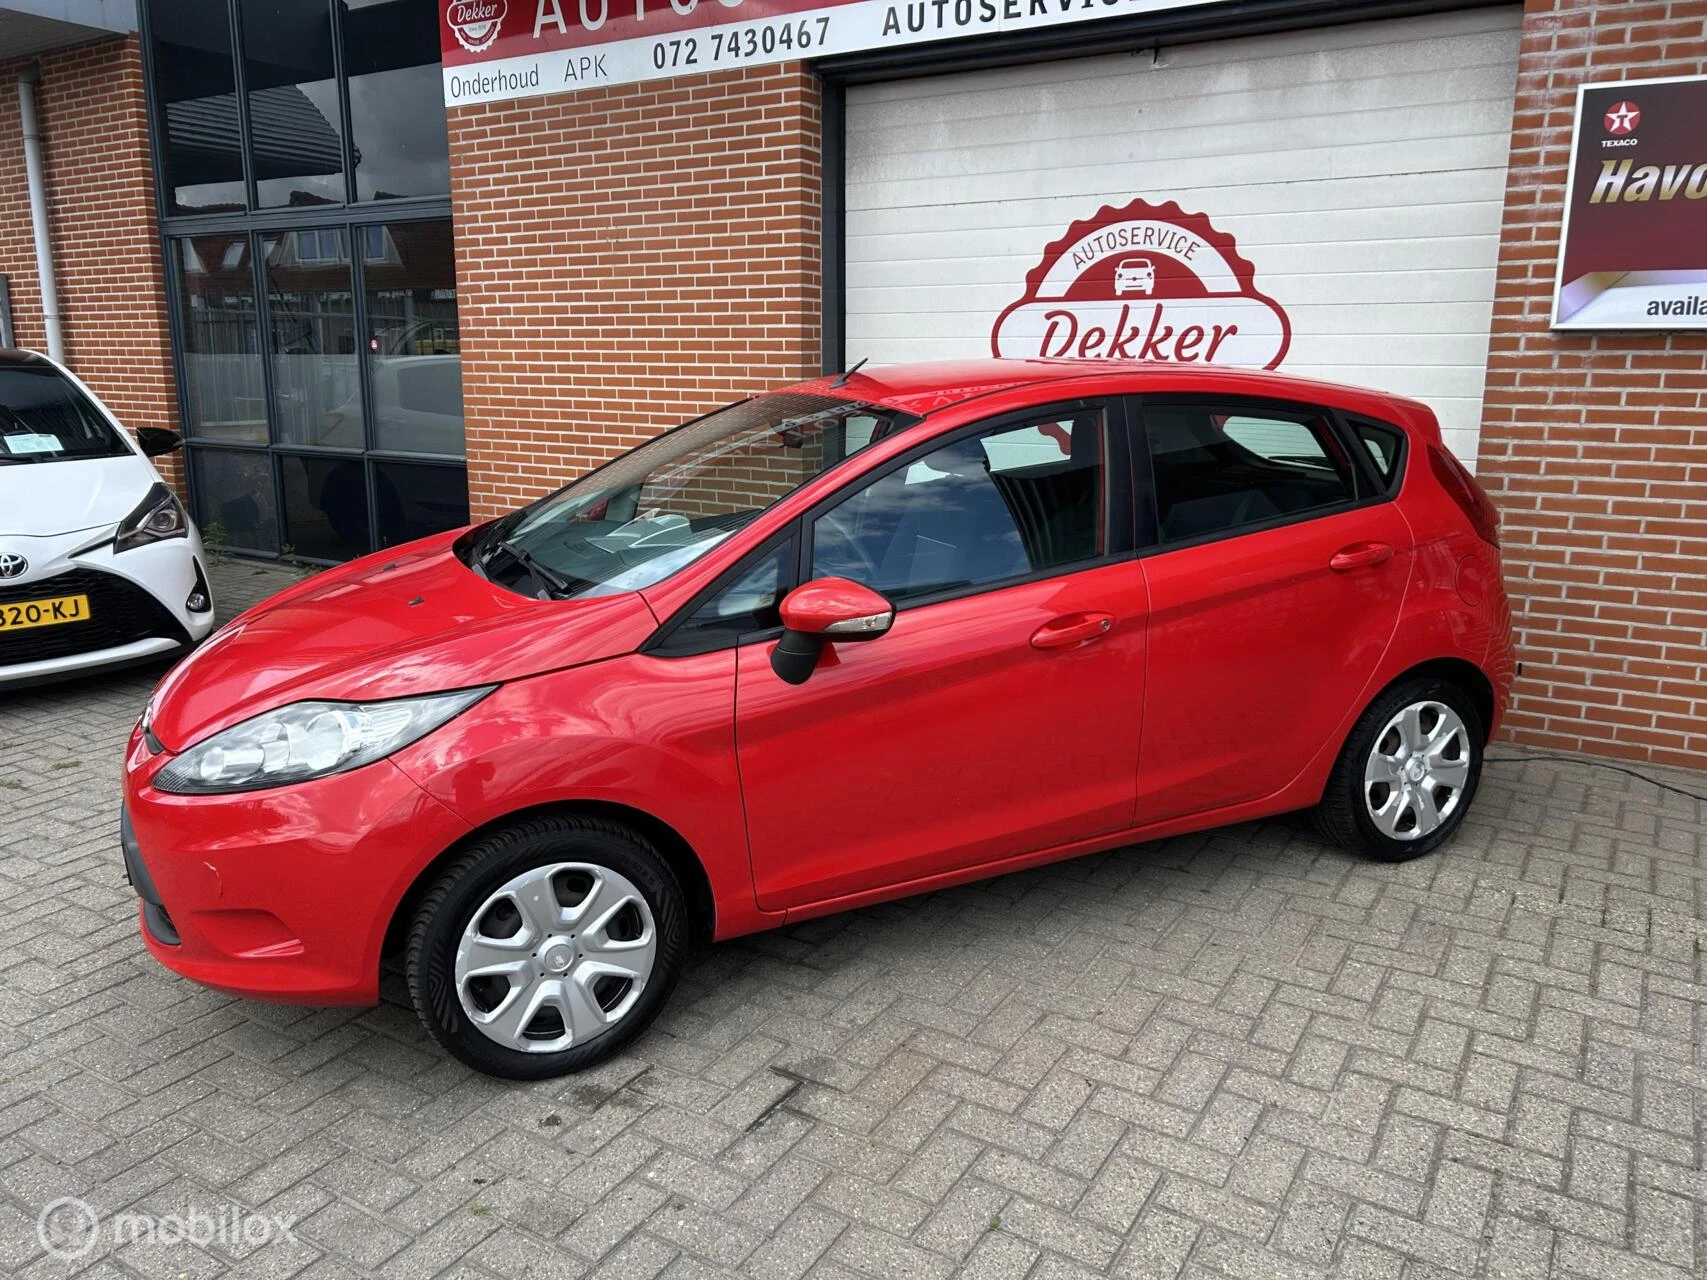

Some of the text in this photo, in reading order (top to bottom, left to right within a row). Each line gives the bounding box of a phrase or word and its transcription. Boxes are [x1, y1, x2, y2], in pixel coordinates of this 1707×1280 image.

[457, 0, 498, 23] Dekker
[653, 17, 831, 70] 072 7430467
[450, 63, 540, 99] Onderhoud
[564, 54, 608, 83] APK
[1600, 138, 1638, 148] TEXACO
[1072, 226, 1201, 270] AUTOSERVICE
[1039, 303, 1239, 364] Dekker
